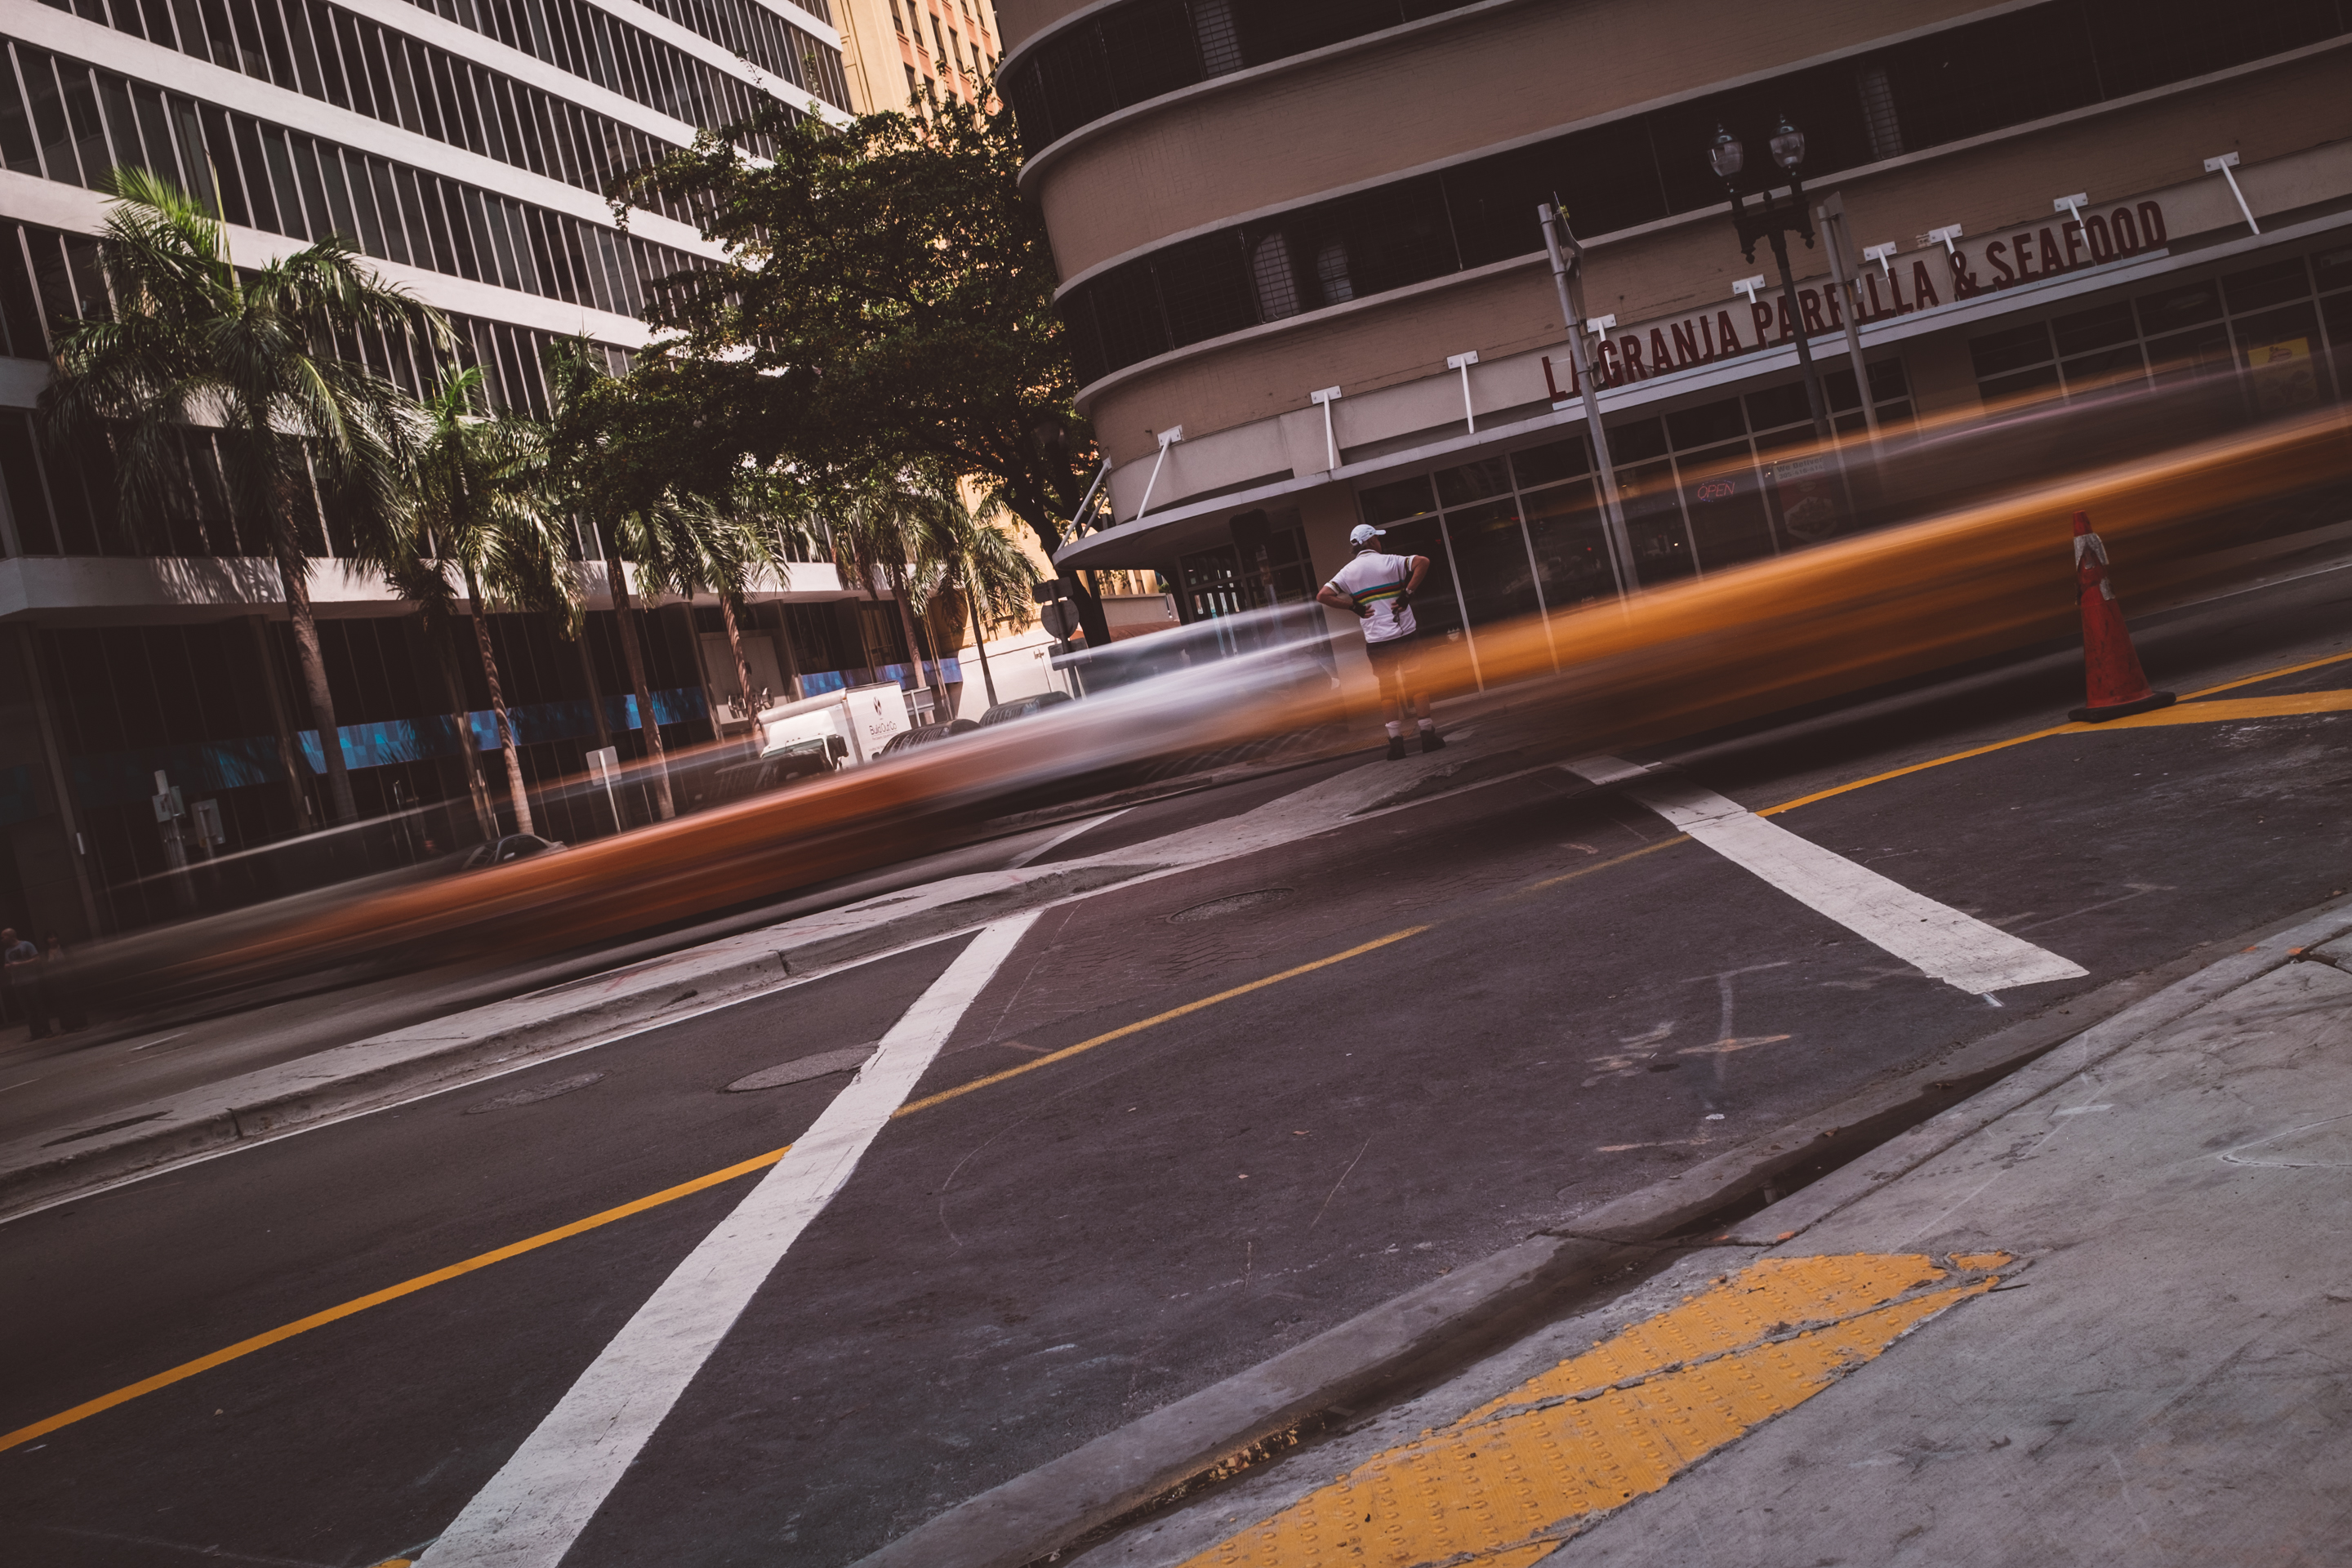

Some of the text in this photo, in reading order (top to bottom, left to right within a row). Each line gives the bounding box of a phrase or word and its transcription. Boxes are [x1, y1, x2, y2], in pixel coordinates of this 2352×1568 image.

[1597, 310, 1744, 388] GRANJA
[1949, 250, 1981, 300] &
[1985, 200, 2167, 291] SEAFOOD
[1776, 465, 1791, 473] We
[1697, 482, 1735, 500] OPEN
